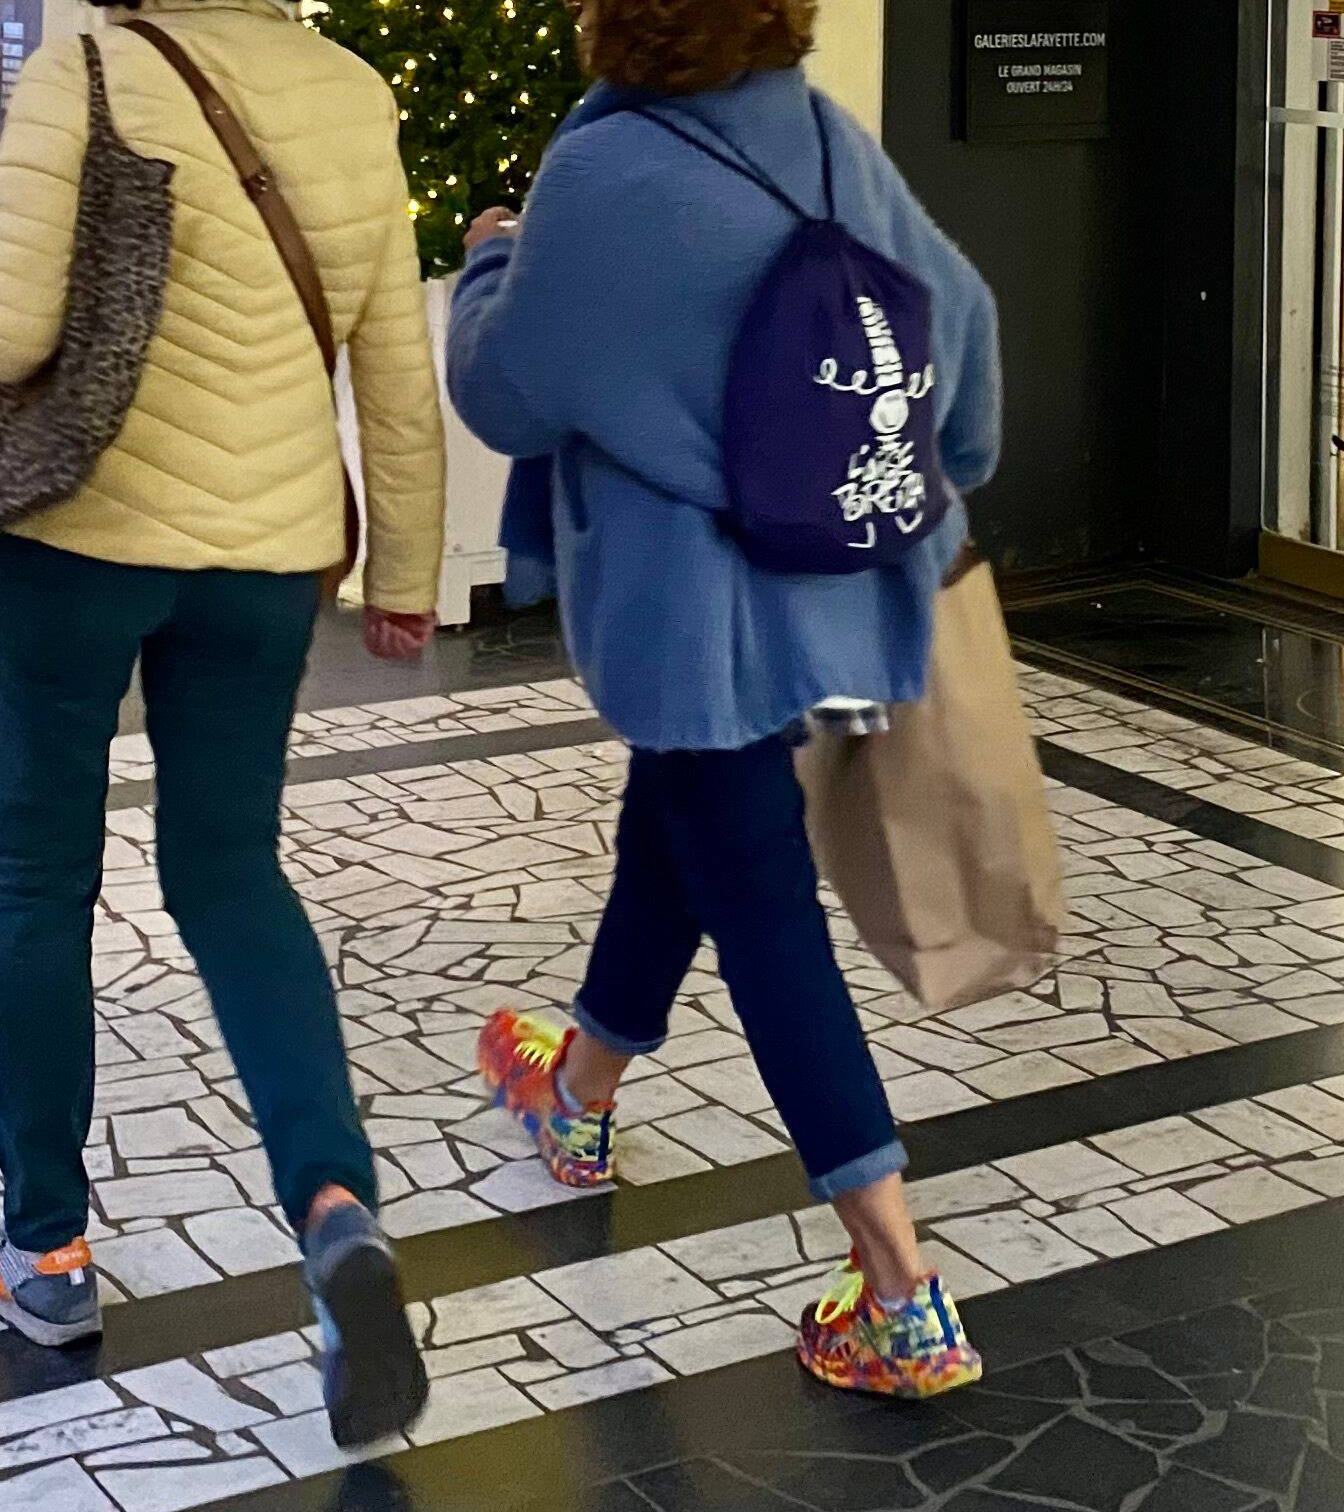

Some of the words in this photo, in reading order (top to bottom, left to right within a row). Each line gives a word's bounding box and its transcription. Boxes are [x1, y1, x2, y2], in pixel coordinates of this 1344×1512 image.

[974, 33, 1106, 48] GALERIESLAFAYETTE.COM
[998, 65, 1009, 78] LE
[1011, 65, 1042, 77] GRAND
[1043, 64, 1083, 76] MAGASIN
[1006, 80, 1041, 94] OUVERT
